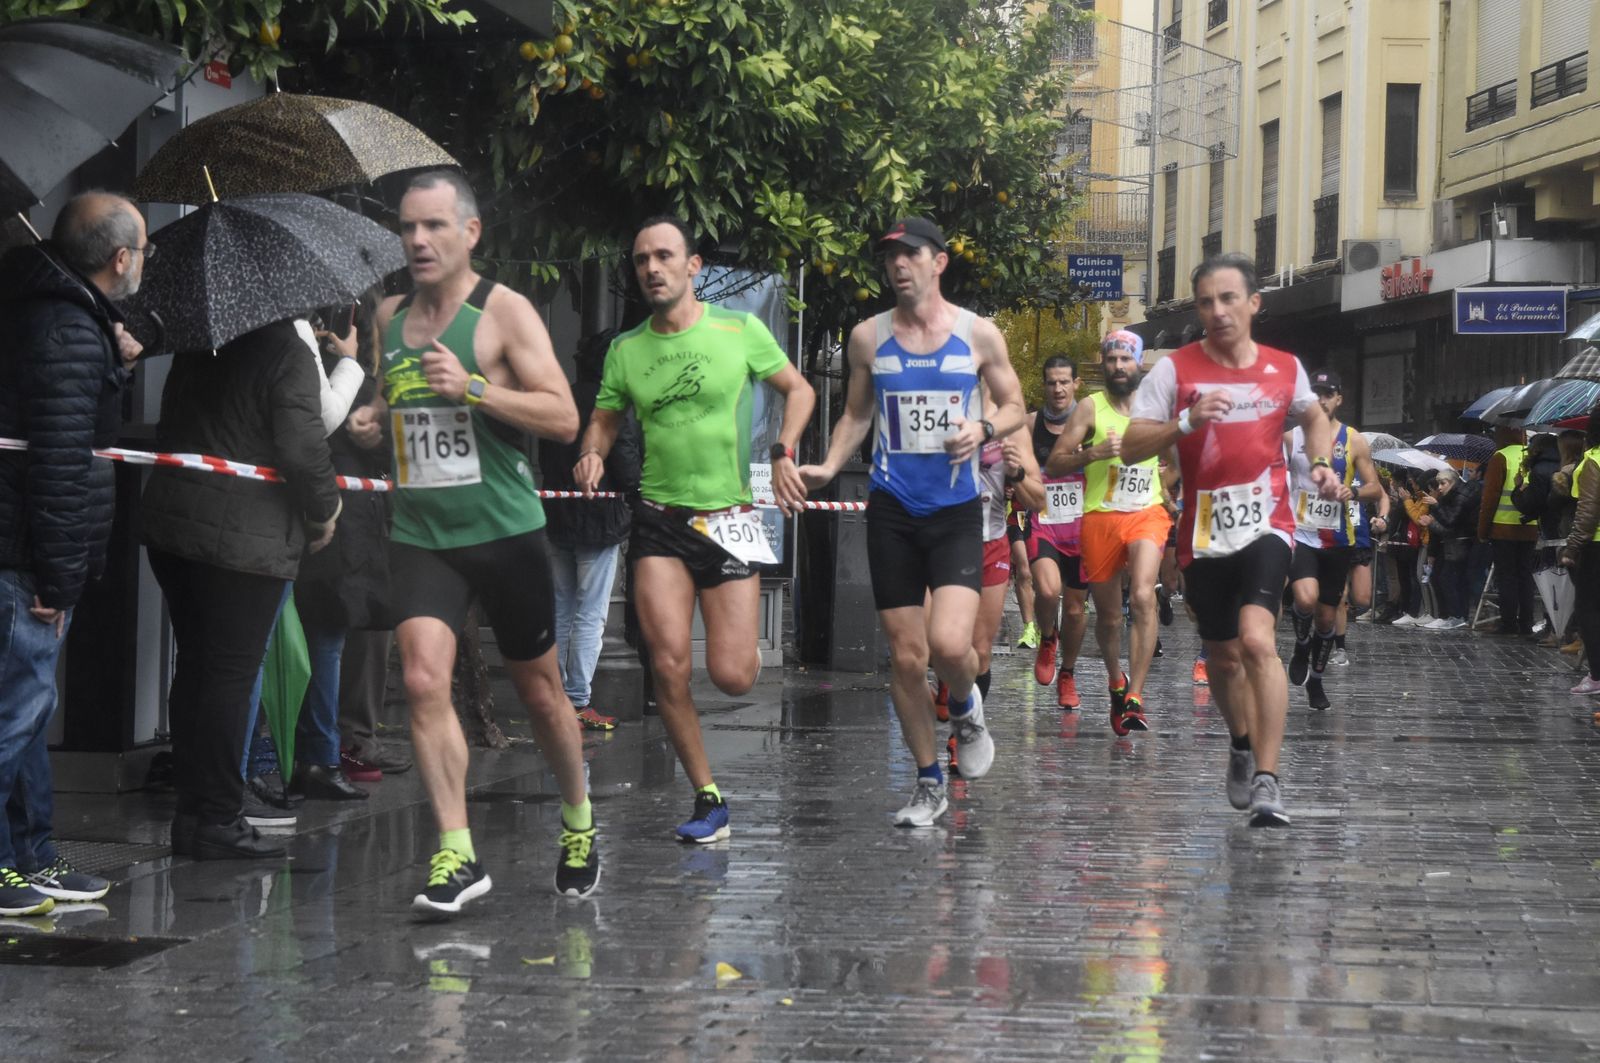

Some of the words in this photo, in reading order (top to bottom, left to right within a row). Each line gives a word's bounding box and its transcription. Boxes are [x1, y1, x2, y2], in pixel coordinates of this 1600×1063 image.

[1069, 269, 1121, 278] Reydental
[1497, 304, 1507, 312] El
[1510, 304, 1545, 312] Palacio
[1511, 312, 1560, 320] Caramelos
[657, 351, 712, 366] DUATLON
[909, 410, 950, 431] 354
[408, 430, 471, 460] 1165
[1120, 477, 1151, 493] 1504
[1053, 492, 1077, 506] 806
[1211, 501, 1262, 531] 1328
[1308, 502, 1338, 518] 1491
